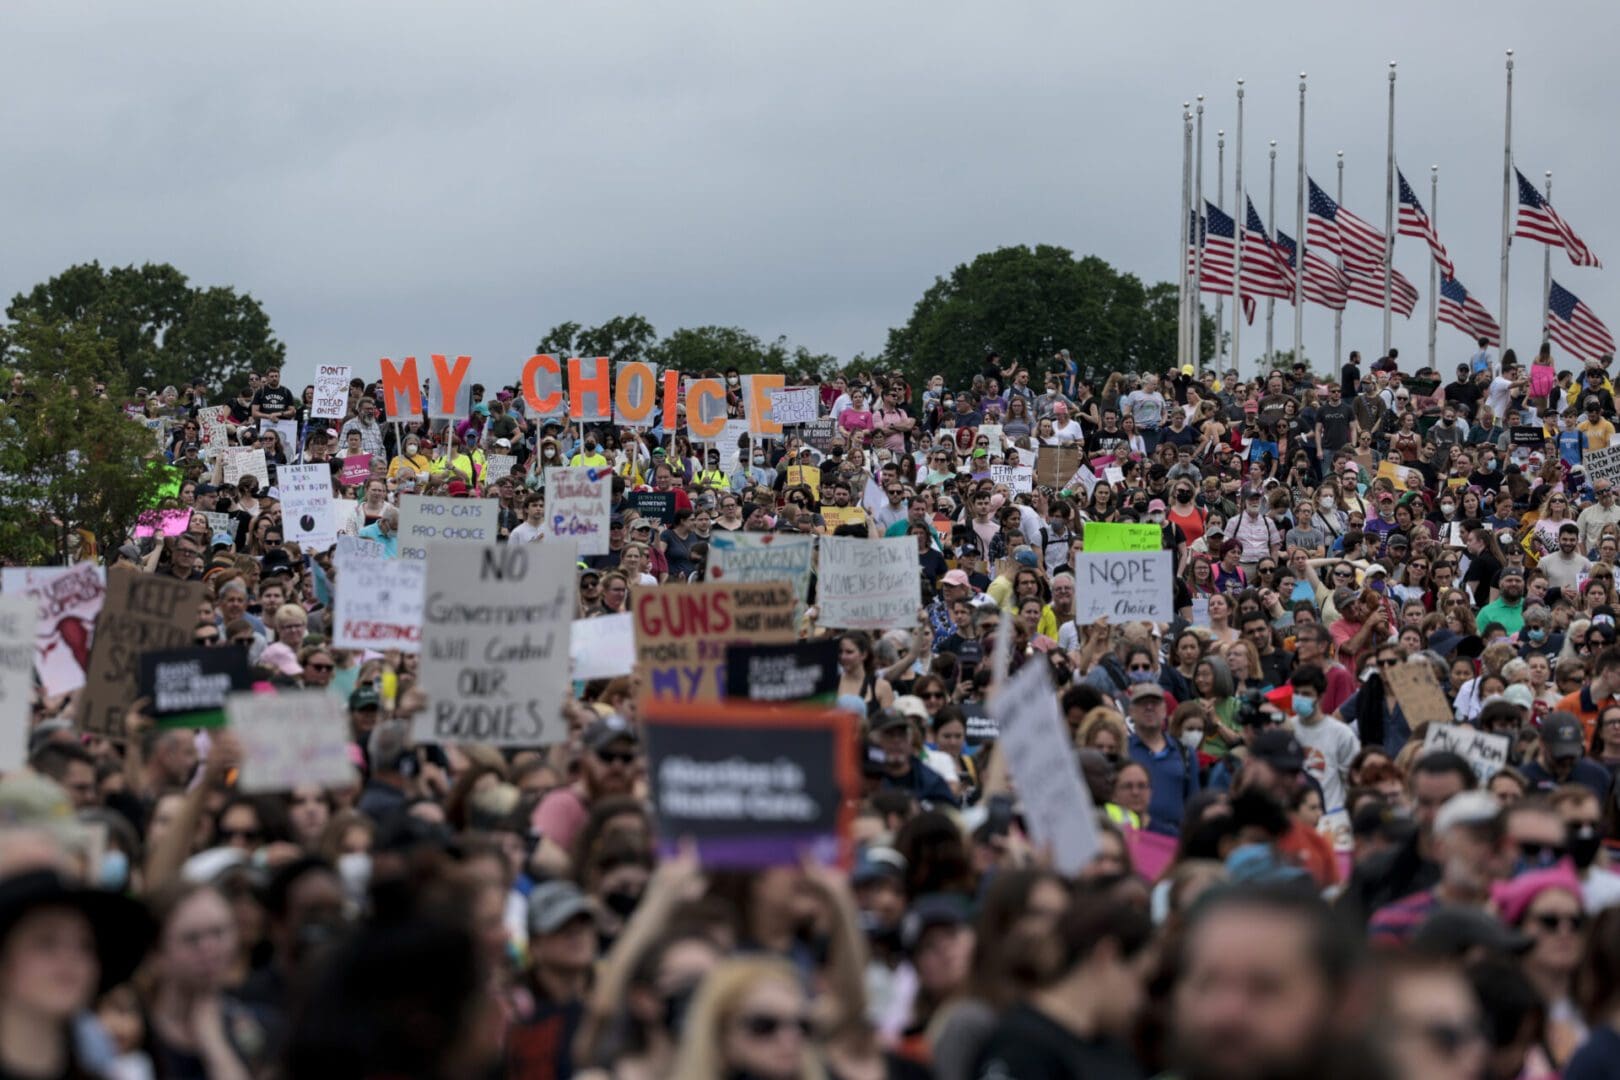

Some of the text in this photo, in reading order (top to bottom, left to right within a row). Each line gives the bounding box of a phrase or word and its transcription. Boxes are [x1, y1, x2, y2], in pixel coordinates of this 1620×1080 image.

[317, 399, 343, 407] TREAD
[380, 353, 785, 438] MY CHOICE
[803, 429, 812, 437] MY
[1588, 458, 1608, 470] EVEN
[420, 503, 481, 517] PRO-CATS
[412, 525, 485, 540] PRO-CHOICE
[480, 547, 529, 583] NO
[820, 538, 849, 564] NOT
[1090, 559, 1156, 587] NOPE
[128, 577, 191, 618] KEEP
[425, 585, 566, 625] Government
[1115, 599, 1159, 615] Choice
[638, 592, 731, 638] GUNS
[484, 631, 554, 664] Control
[642, 641, 688, 662] MORE
[456, 667, 508, 698] OUR
[653, 664, 703, 705] MY
[434, 700, 544, 742] BODIES
